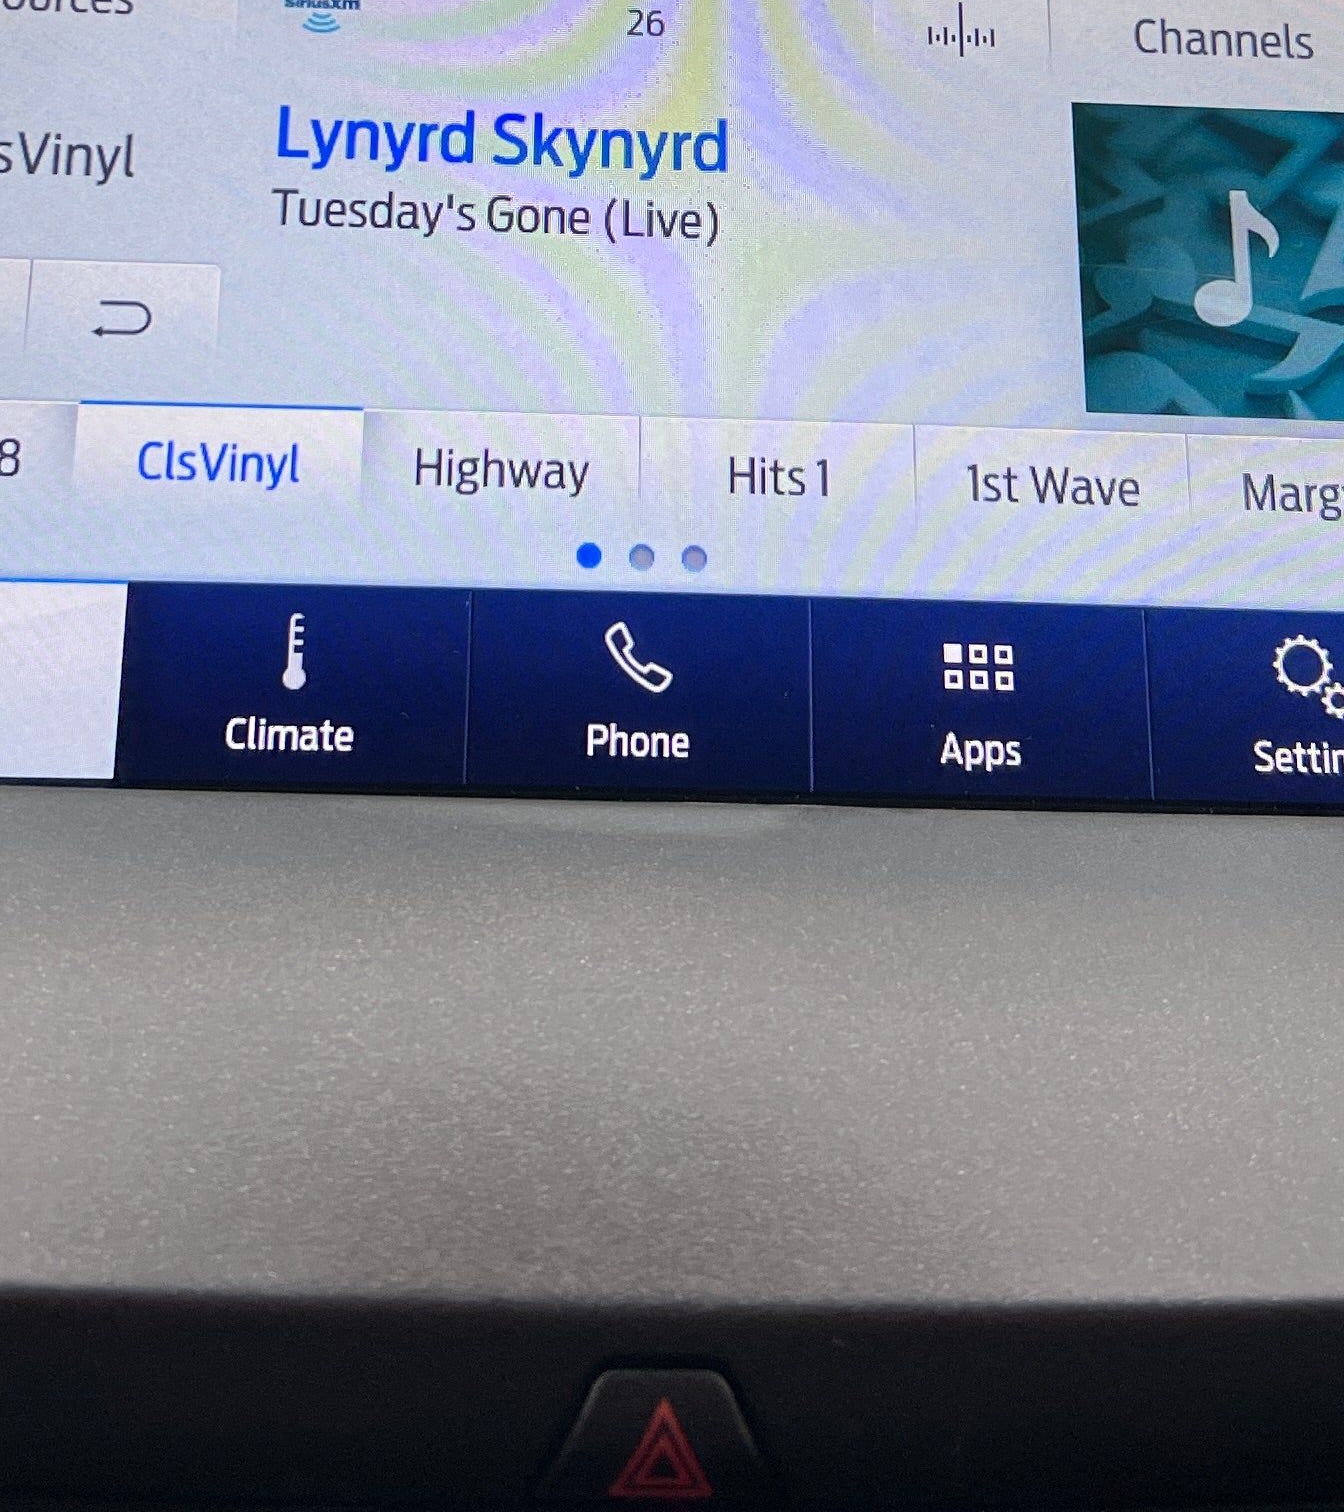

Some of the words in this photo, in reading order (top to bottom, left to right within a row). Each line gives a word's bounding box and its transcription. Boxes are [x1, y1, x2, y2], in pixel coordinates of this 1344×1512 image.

[625, 8, 667, 38] 26
[1133, 17, 1315, 61] Channels
[276, 103, 476, 174] Lynyrd
[491, 110, 728, 182] Skynyrd
[270, 187, 477, 239] Tuesday's
[486, 193, 591, 236] Gone
[603, 196, 720, 249] (Live)
[137, 439, 300, 492] ClsVinyl
[414, 446, 591, 499] Highway
[728, 455, 807, 497] Hits
[815, 457, 829, 498] 1
[966, 463, 1020, 504] 1st
[1028, 464, 1141, 508] Wave
[224, 714, 355, 753] Climate
[585, 721, 691, 759] Phone
[939, 730, 1023, 773] Apps
